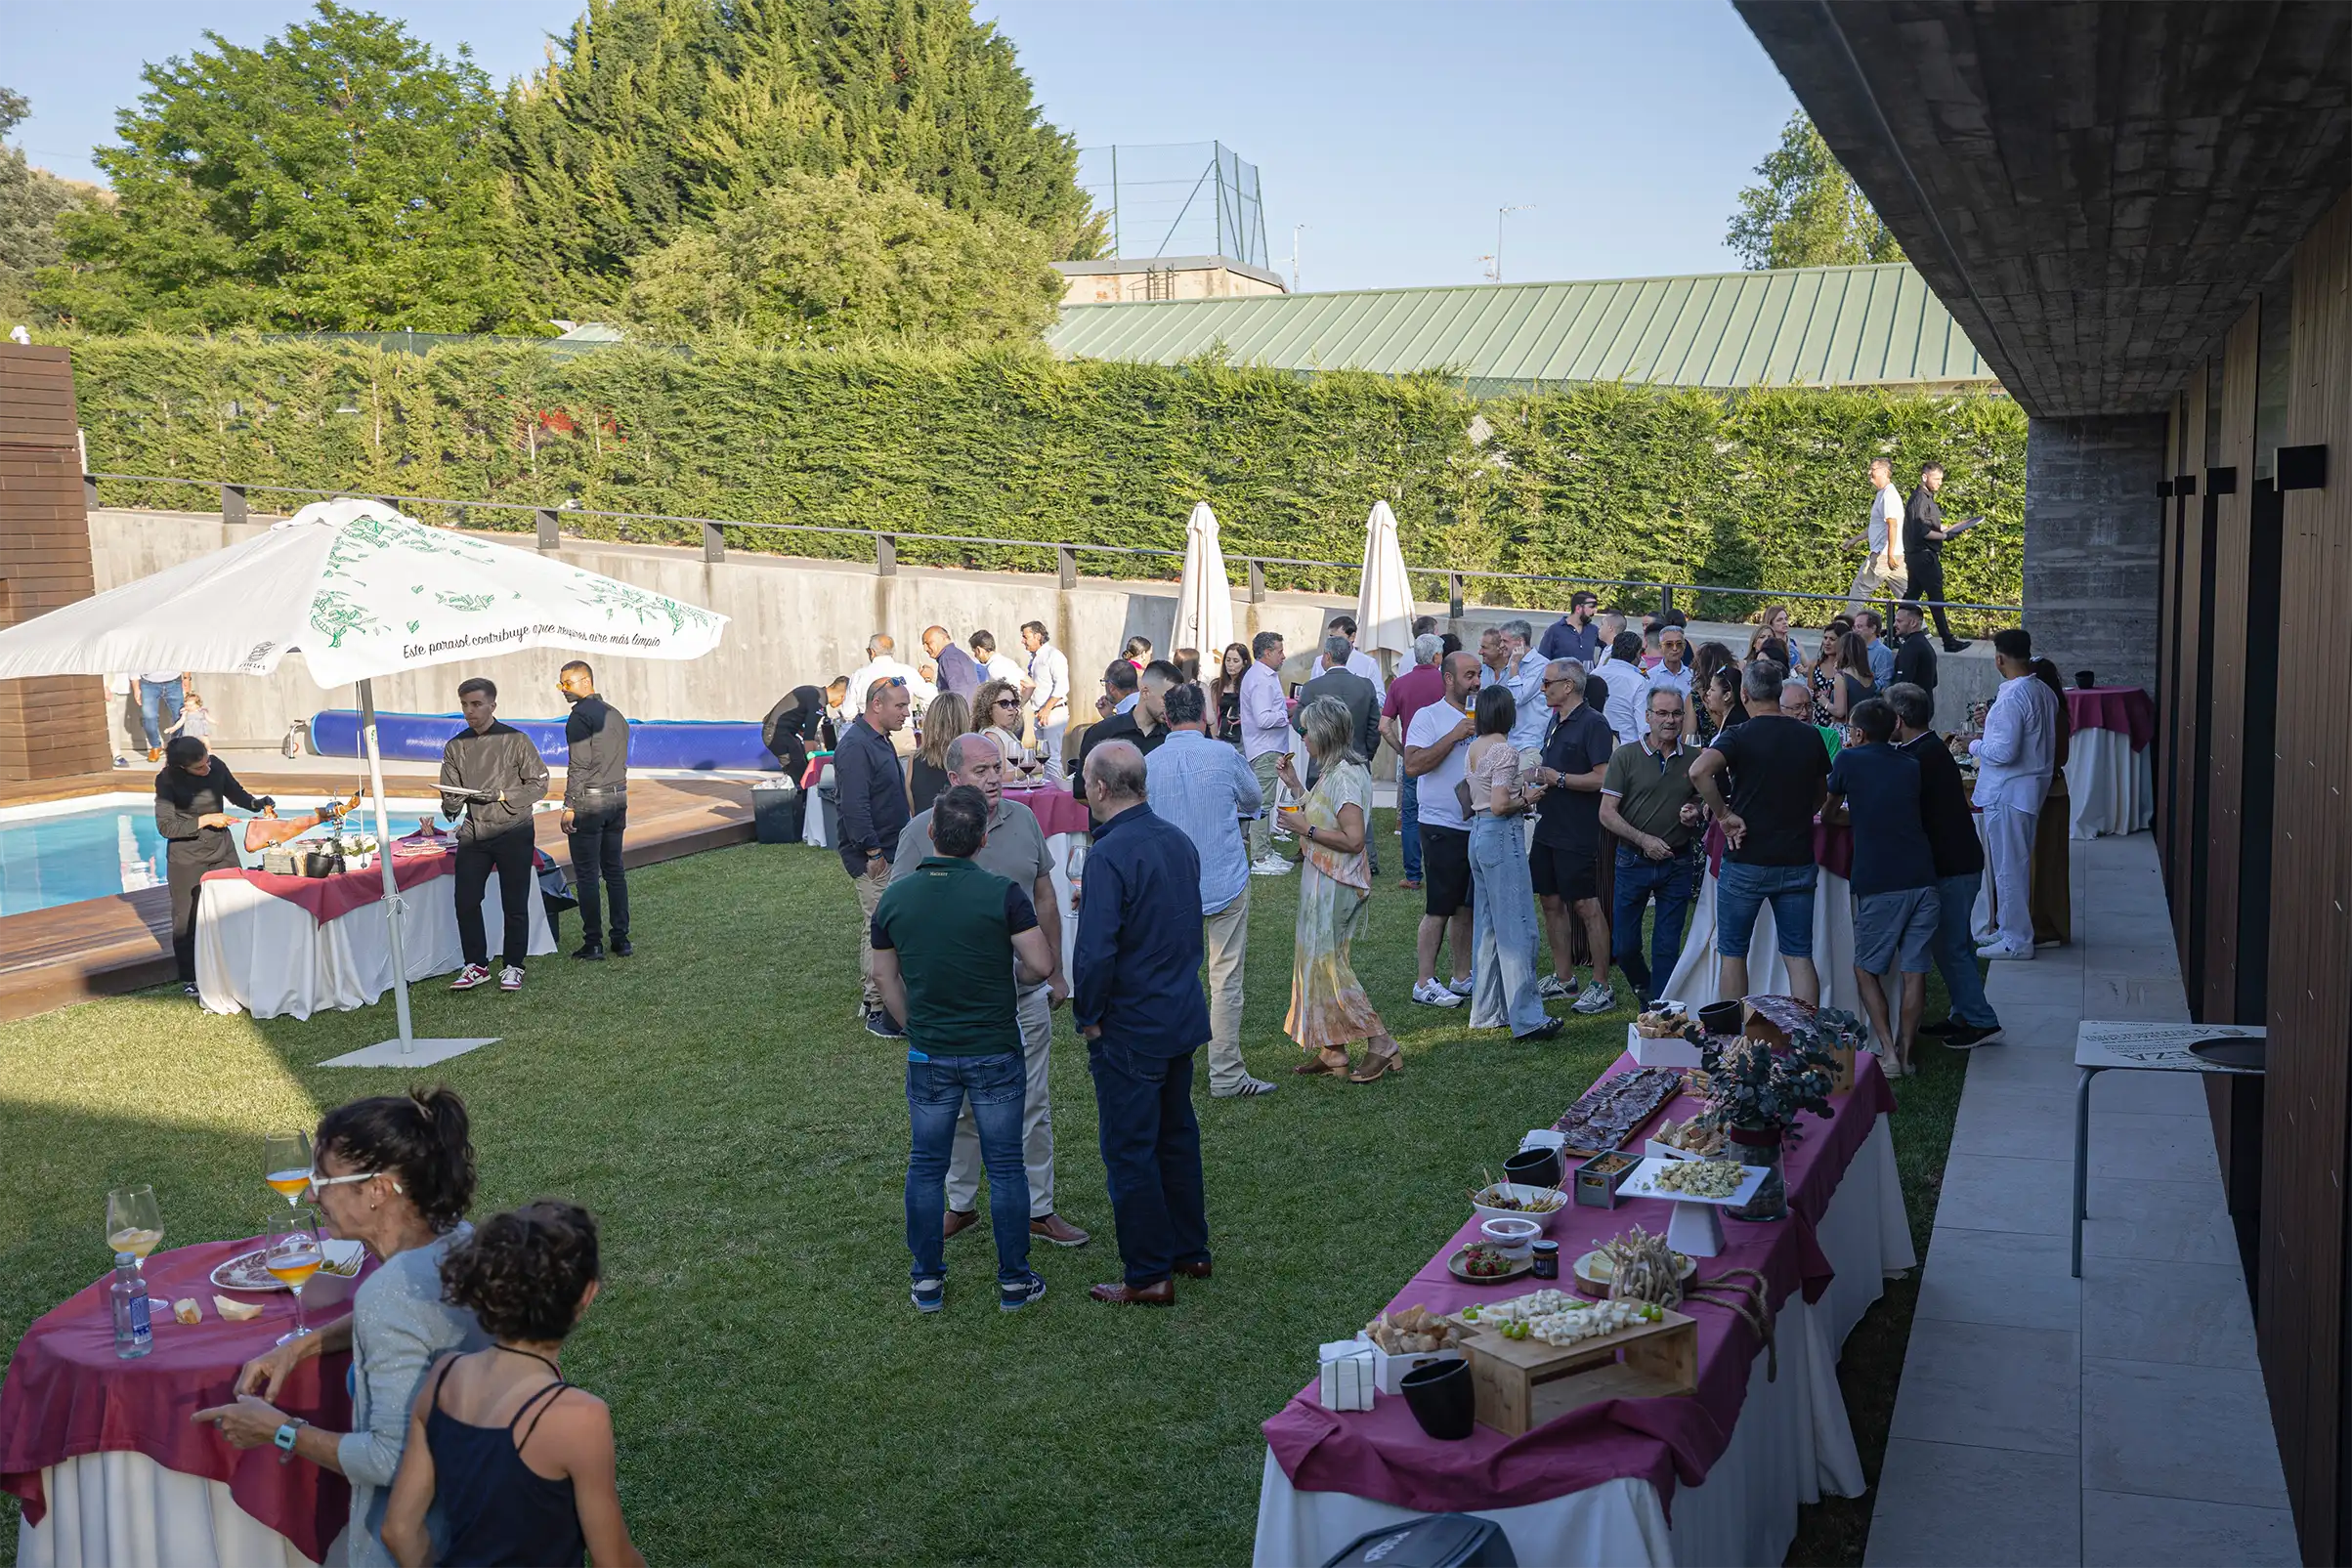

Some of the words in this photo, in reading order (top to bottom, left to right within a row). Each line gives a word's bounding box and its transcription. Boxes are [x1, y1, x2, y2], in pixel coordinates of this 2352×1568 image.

[403, 644, 426, 659] Este
[429, 634, 471, 657] parasol
[471, 625, 531, 643] contribuye
[588, 632, 608, 643] aire
[609, 633, 629, 645] más
[631, 632, 661, 649] limpio
